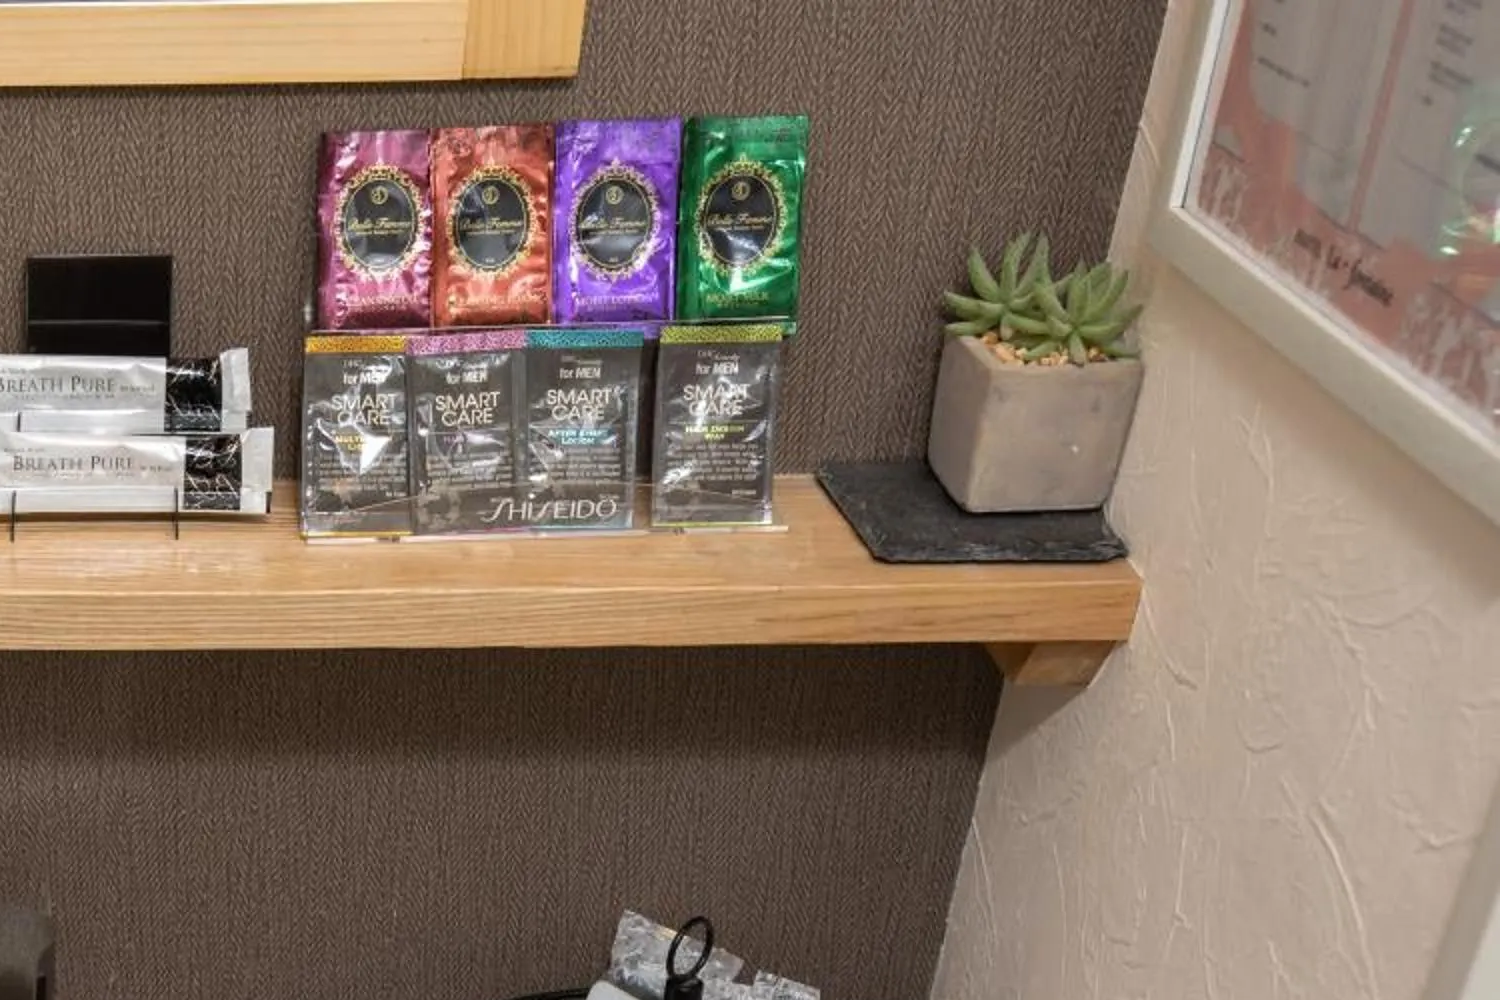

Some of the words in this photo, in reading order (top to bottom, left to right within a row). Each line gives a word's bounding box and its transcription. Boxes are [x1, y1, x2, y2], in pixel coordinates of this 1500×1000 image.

[576, 367, 601, 379] MEN
[70, 374, 116, 393] PURE
[683, 383, 751, 402] SMART
[331, 391, 397, 411] SMART
[435, 391, 501, 411] SMART
[546, 386, 613, 405] SMART
[337, 408, 390, 427] CARE
[441, 407, 494, 427] CARE
[552, 404, 605, 423] CARE
[688, 400, 744, 417] CARE
[12, 455, 82, 472] BREATH
[91, 455, 133, 471] PURE
[477, 492, 619, 523] SHISEIDO
